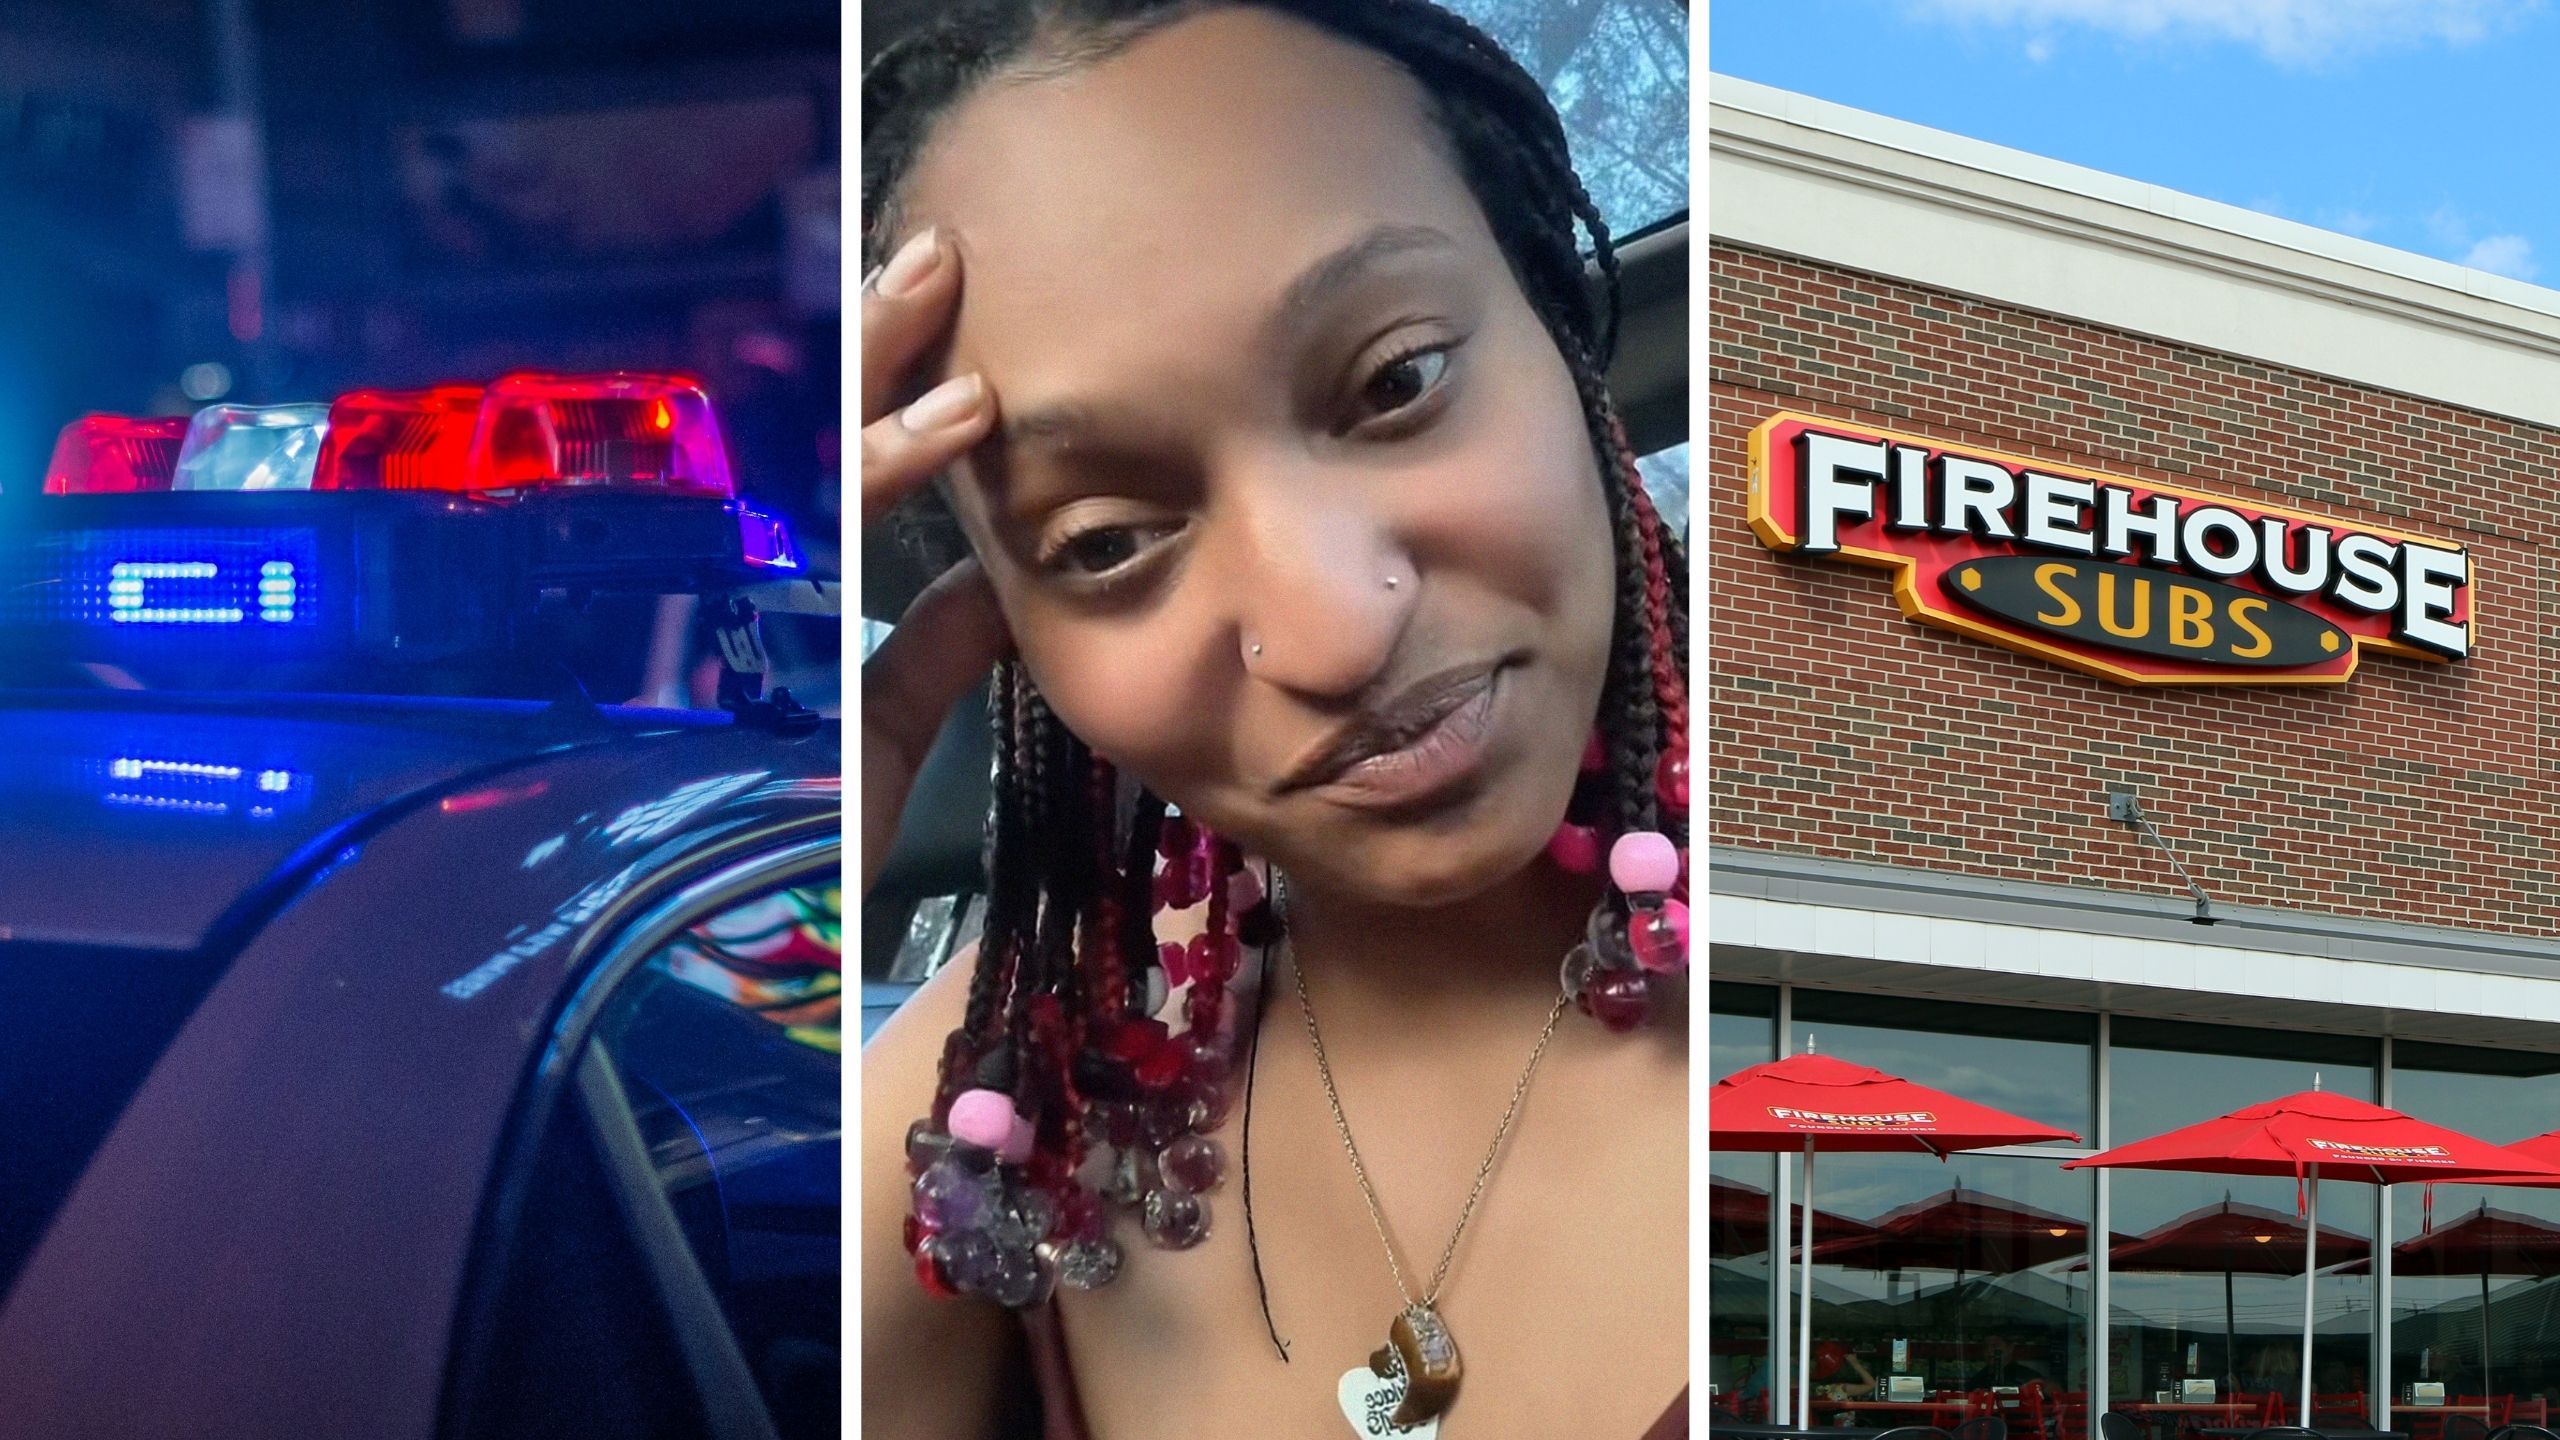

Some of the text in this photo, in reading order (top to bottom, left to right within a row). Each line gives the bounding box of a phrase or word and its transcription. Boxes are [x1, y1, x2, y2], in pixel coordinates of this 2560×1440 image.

[1798, 429, 2468, 657] FIREHOUSE
[2033, 563, 2274, 658] SUBS
[1773, 1108, 1932, 1123] FIREHOUSE
[2311, 1140, 2447, 1156] FIREHOUSE
